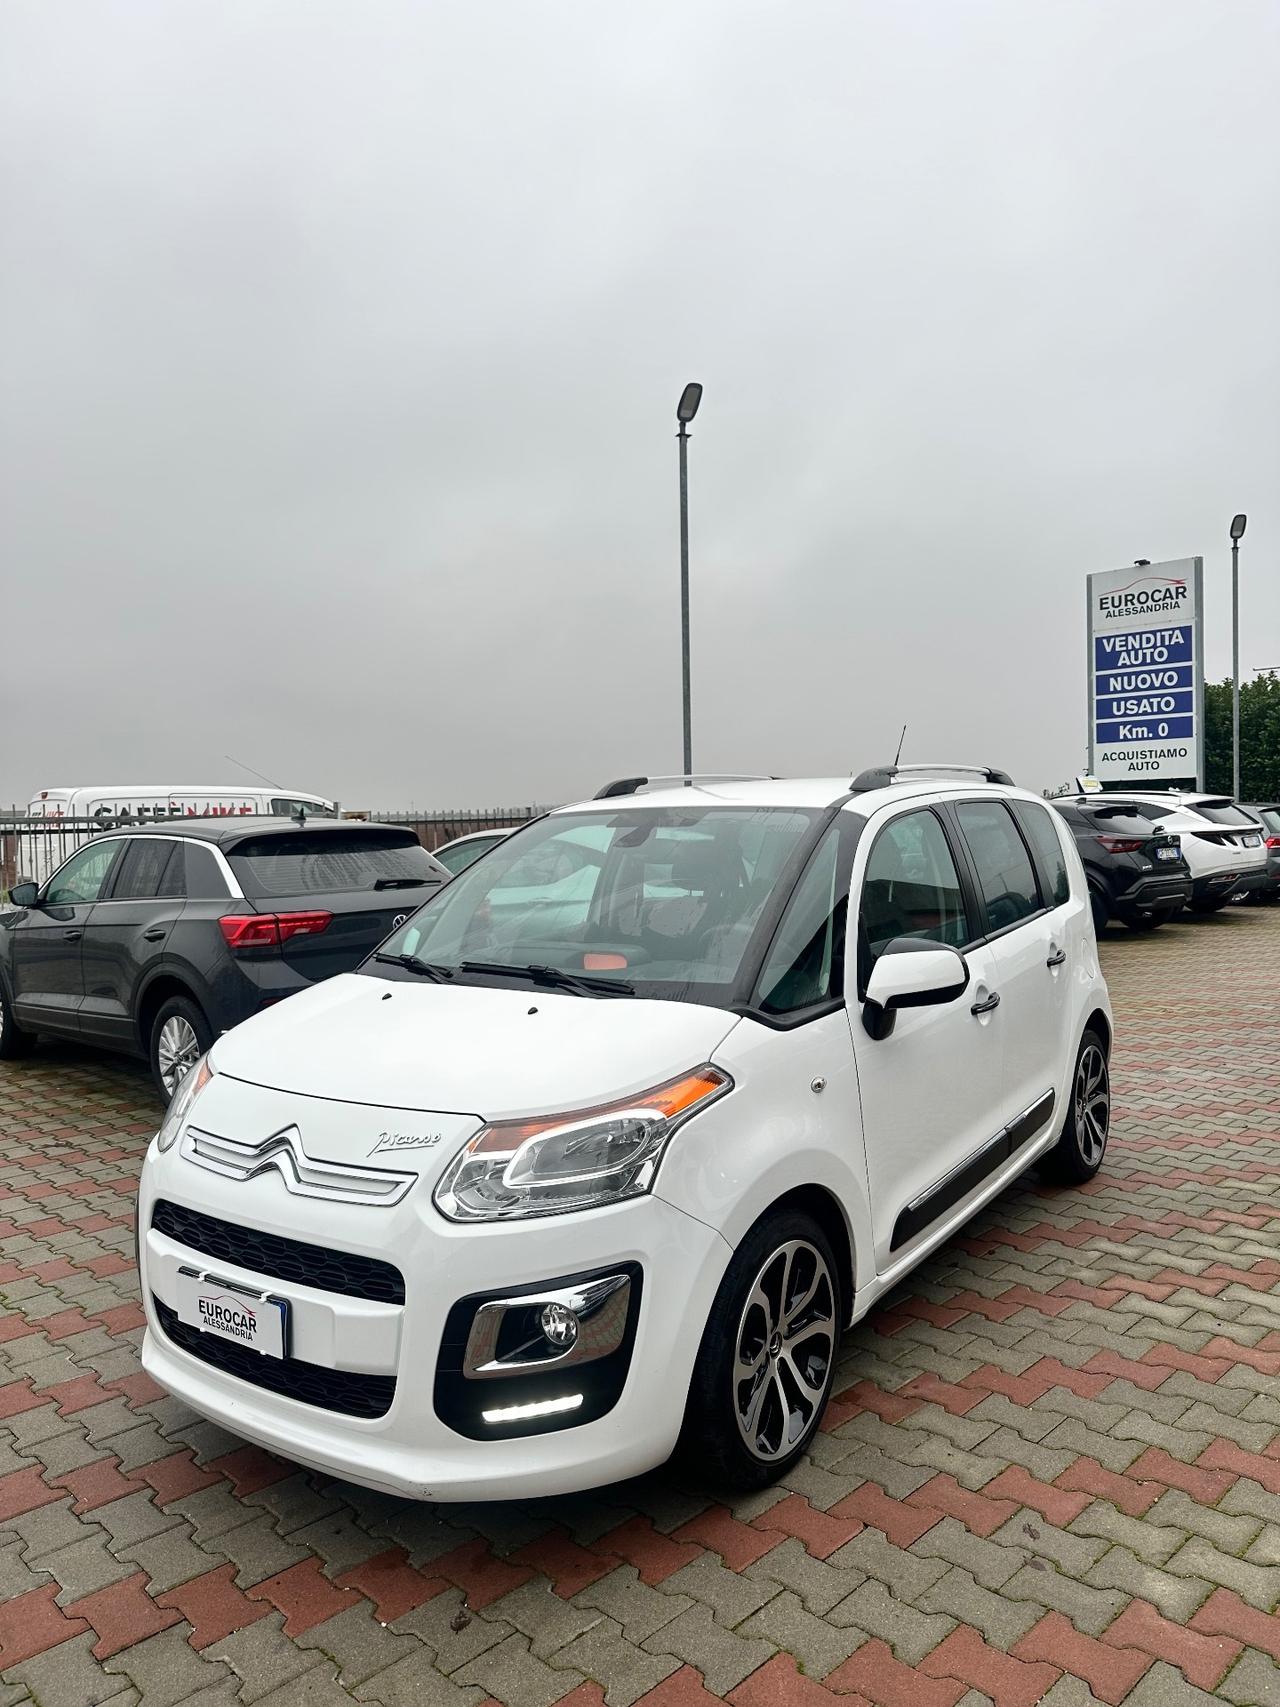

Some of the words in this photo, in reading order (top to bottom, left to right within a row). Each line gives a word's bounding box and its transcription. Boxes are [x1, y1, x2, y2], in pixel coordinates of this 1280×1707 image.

[1099, 585, 1188, 611] EUROCAR
[1105, 600, 1181, 619] ALESSANDRIA
[1102, 629, 1184, 653] VENDITA
[1117, 647, 1169, 667] AUTO
[1109, 671, 1178, 692] NUOVO
[1112, 696, 1176, 716] USATO
[1119, 723, 1153, 740] Km.
[1158, 722, 1169, 737] 0
[1101, 747, 1188, 762] ACQUISTIAMO
[1127, 761, 1160, 772] AUTO
[199, 1299, 257, 1333] EUROCAR
[203, 1316, 253, 1341] ALESSANDRIA
